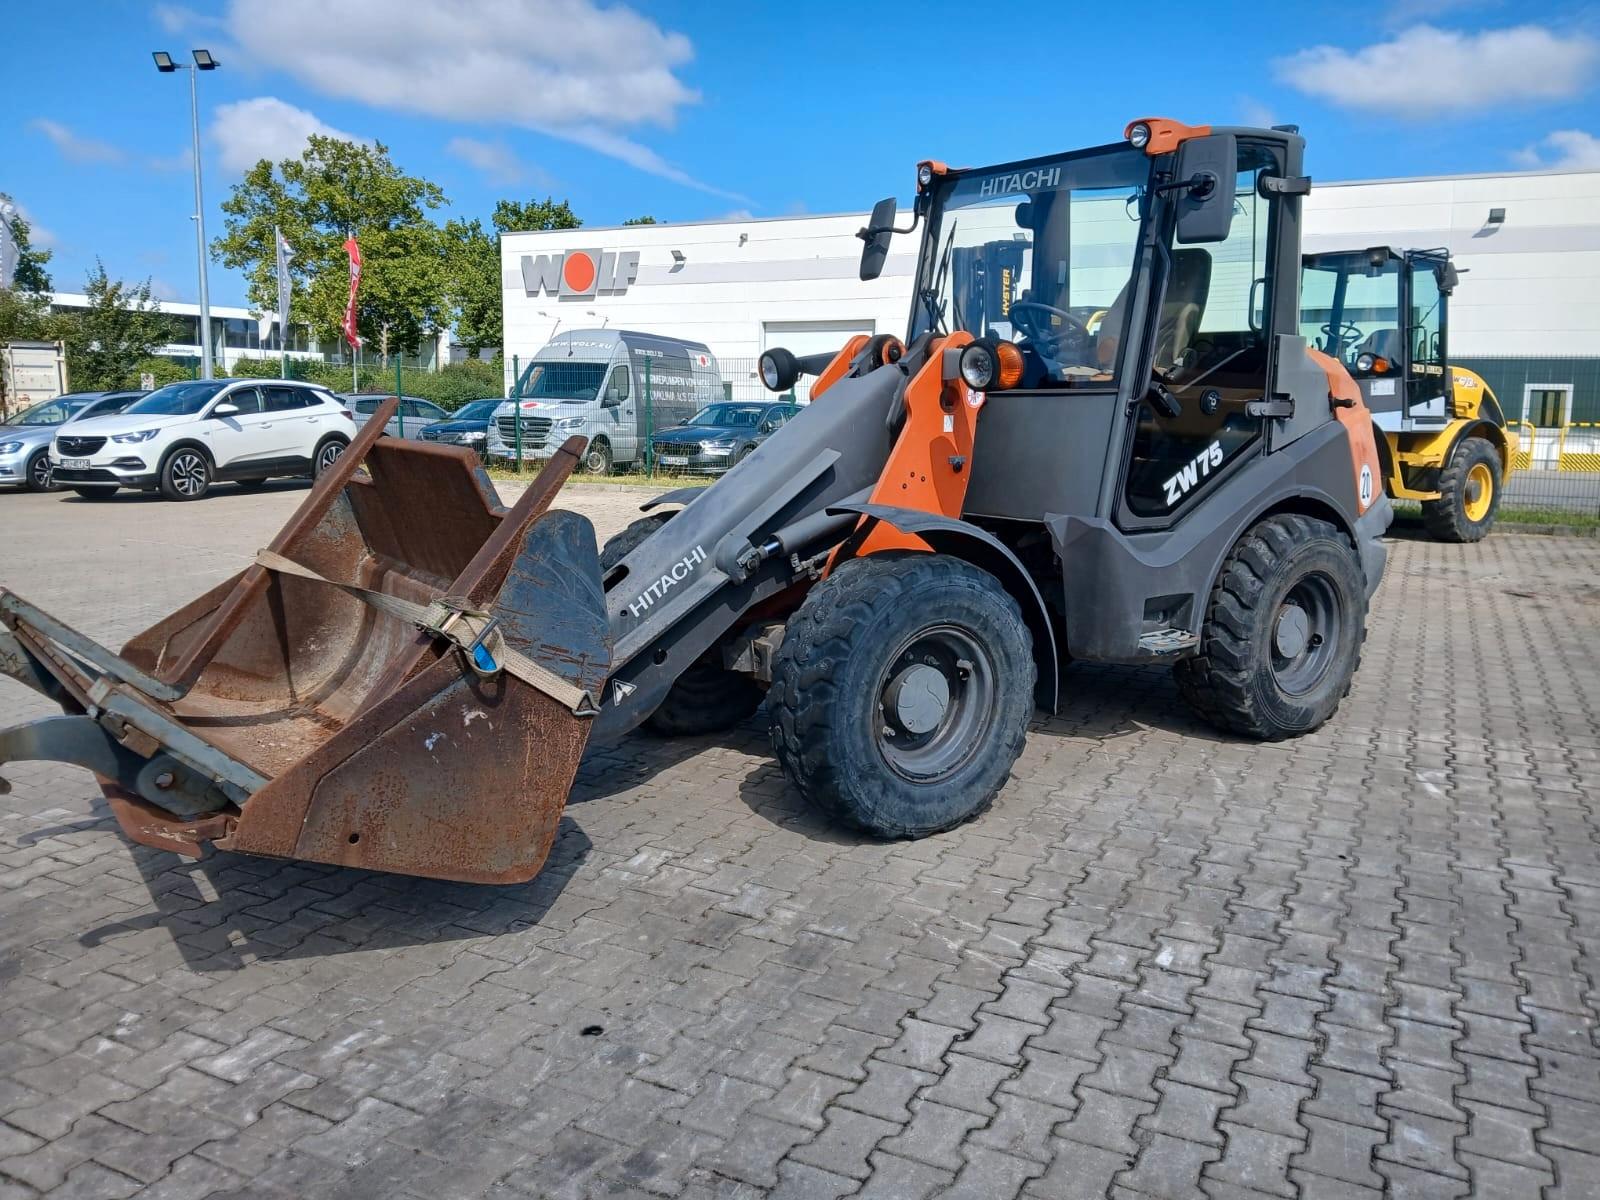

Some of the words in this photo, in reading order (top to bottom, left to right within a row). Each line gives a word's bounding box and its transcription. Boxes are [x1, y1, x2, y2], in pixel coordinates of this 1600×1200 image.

[980, 168, 1060, 197] HITACHI
[520, 248, 640, 302] WOLF
[1002, 269, 1011, 316] HYSTER
[1162, 440, 1223, 506] ZW75
[1362, 472, 1370, 499] 20
[628, 545, 707, 617] HITACHI
